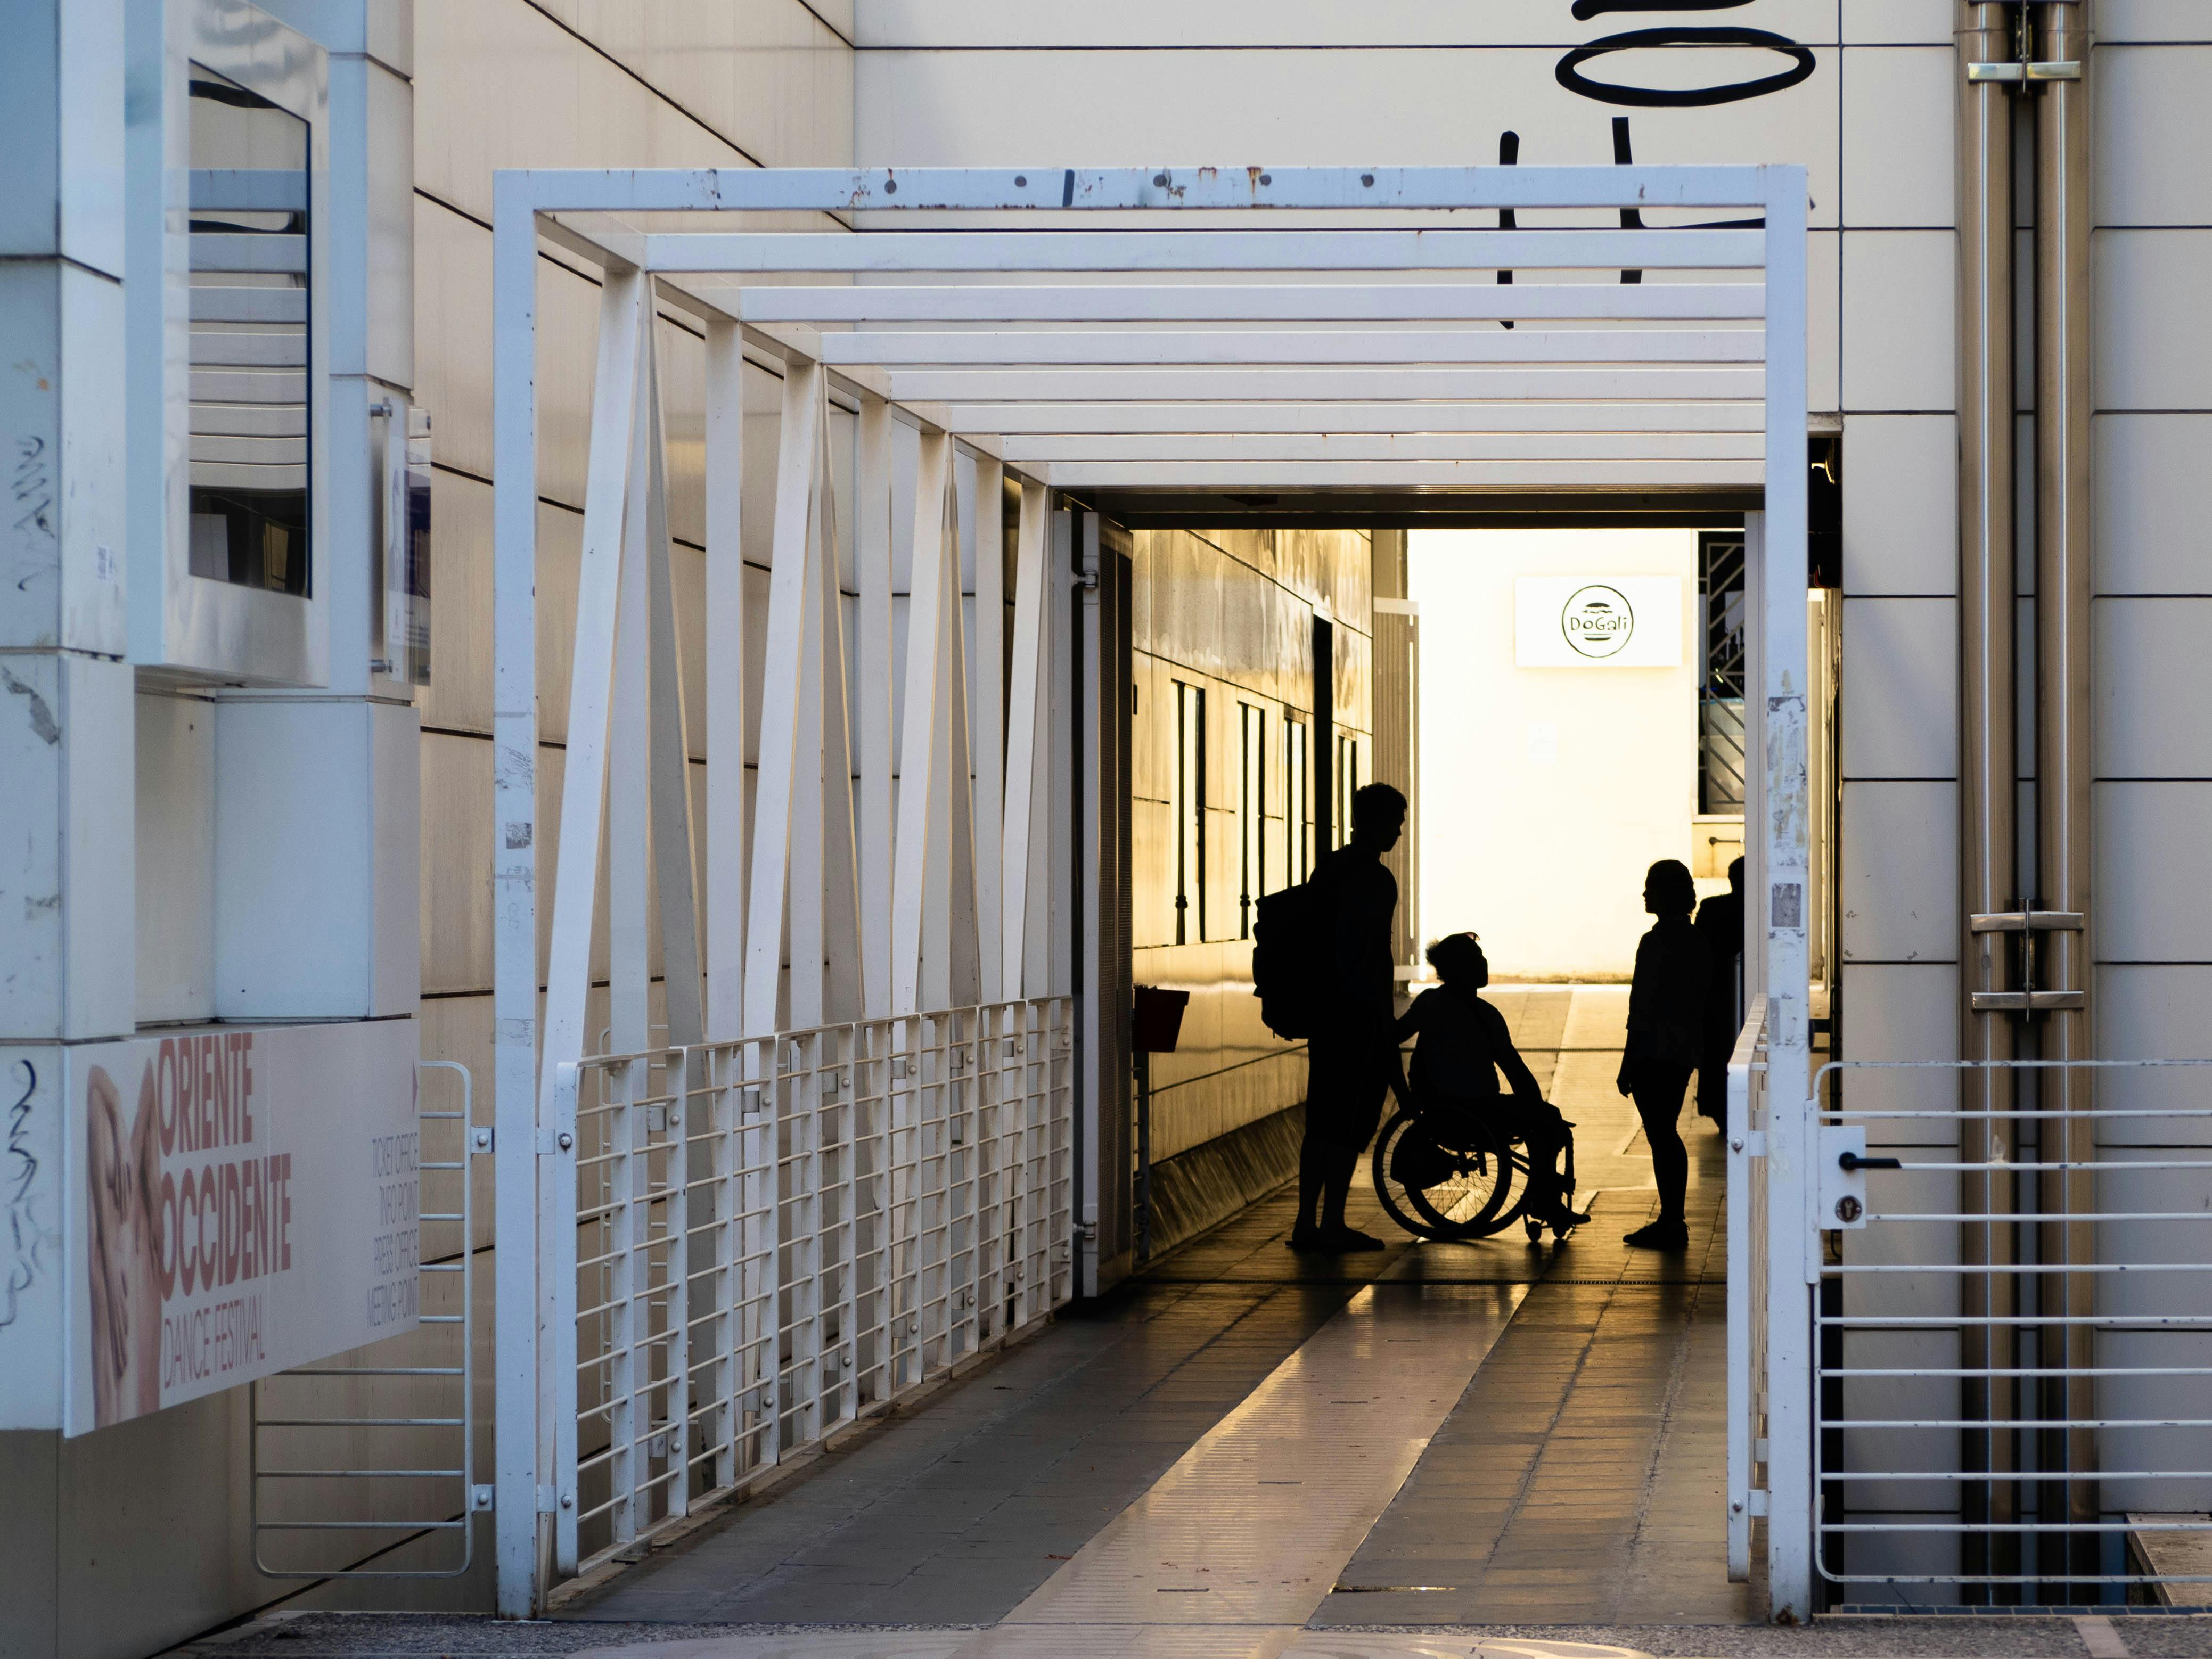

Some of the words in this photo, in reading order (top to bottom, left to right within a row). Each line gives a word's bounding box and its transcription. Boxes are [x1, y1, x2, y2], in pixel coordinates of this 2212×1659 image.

[157, 1032, 253, 1157] ORIENTE
[372, 1136, 394, 1178] TICKET
[395, 1132, 418, 1174] OFFICE
[159, 1153, 291, 1302] OCCIDENTE
[379, 1185, 397, 1225] INFO
[398, 1180, 418, 1223] POINT
[374, 1233, 393, 1276] PRESS
[395, 1228, 417, 1272] OFFICE
[366, 1282, 396, 1329] MEETING
[398, 1276, 417, 1319] POINT
[164, 1307, 210, 1389] DANCE
[215, 1294, 265, 1373] FESTIVAL
